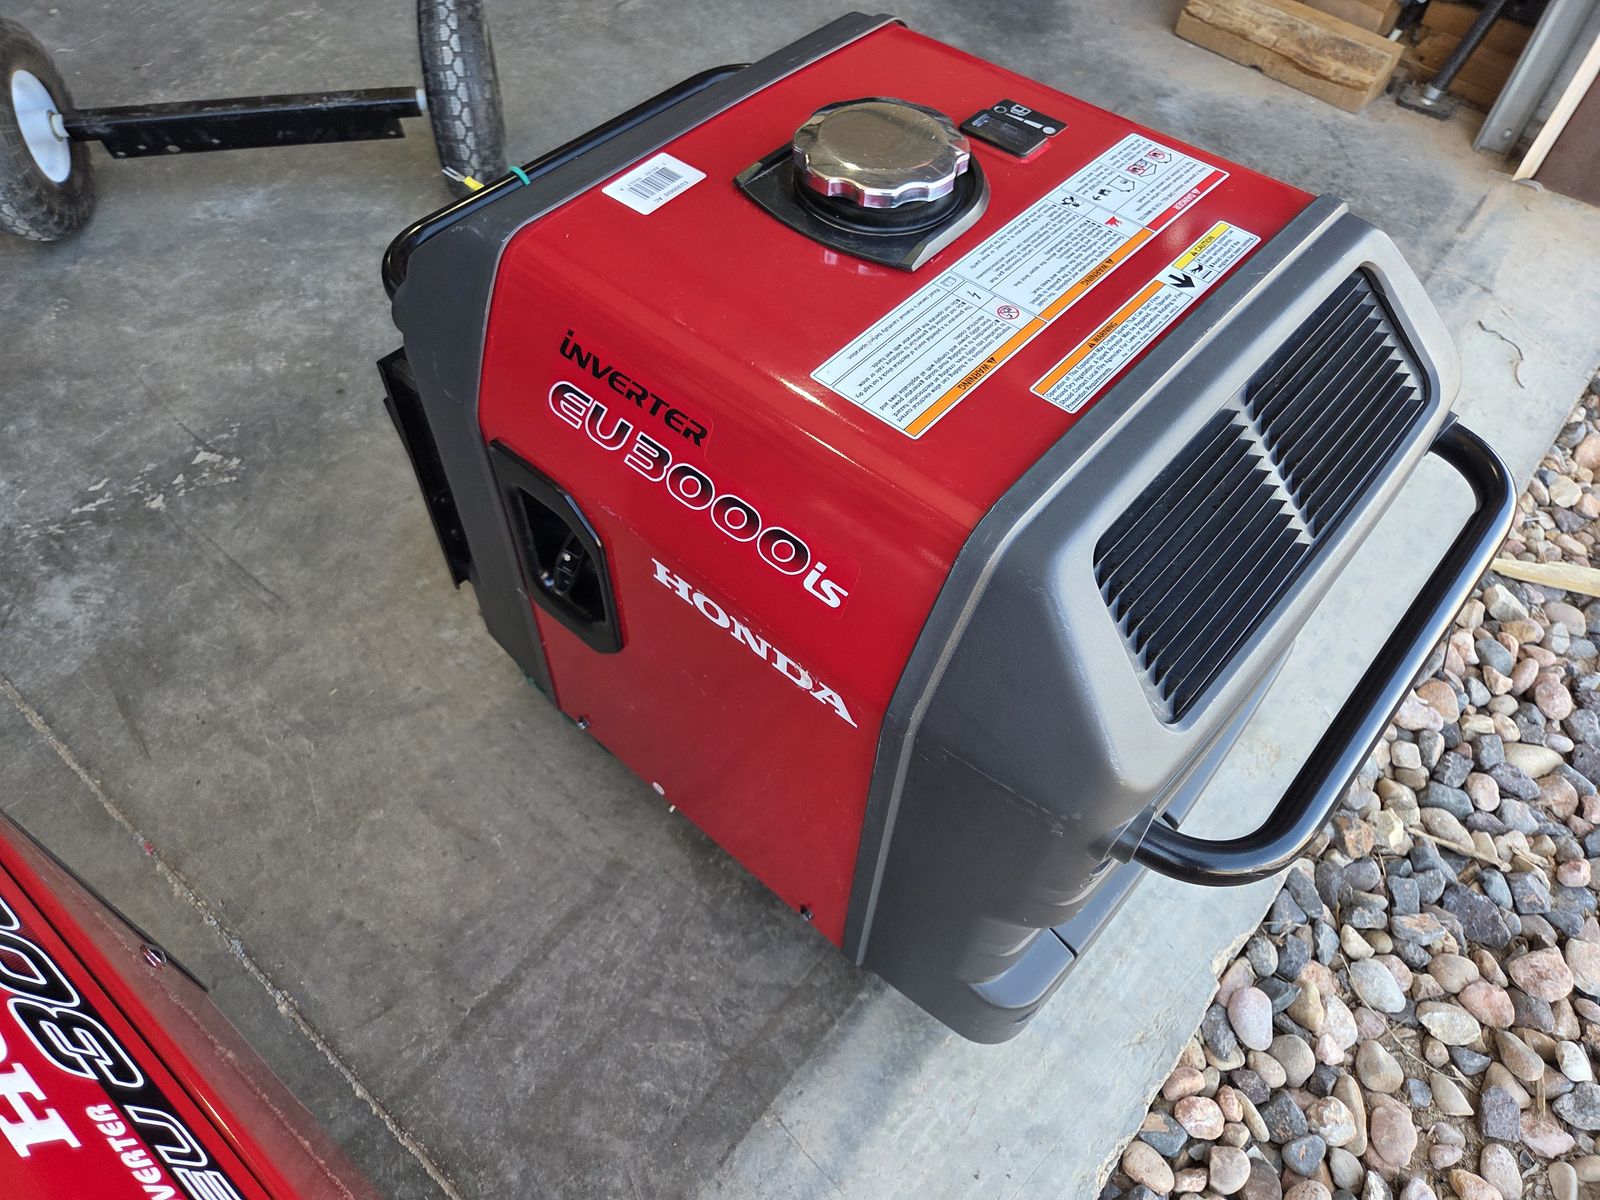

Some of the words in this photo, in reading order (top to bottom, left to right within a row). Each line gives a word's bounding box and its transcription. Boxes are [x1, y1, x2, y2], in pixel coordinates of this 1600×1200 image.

[1171, 191, 1198, 210] DANGER
[1193, 234, 1215, 252] CAUTION
[1079, 263, 1110, 286] WARNING
[1091, 321, 1118, 343] WARNING
[956, 362, 991, 391] WARNING
[548, 381, 849, 608] EU3000is
[651, 557, 858, 728] HONDA
